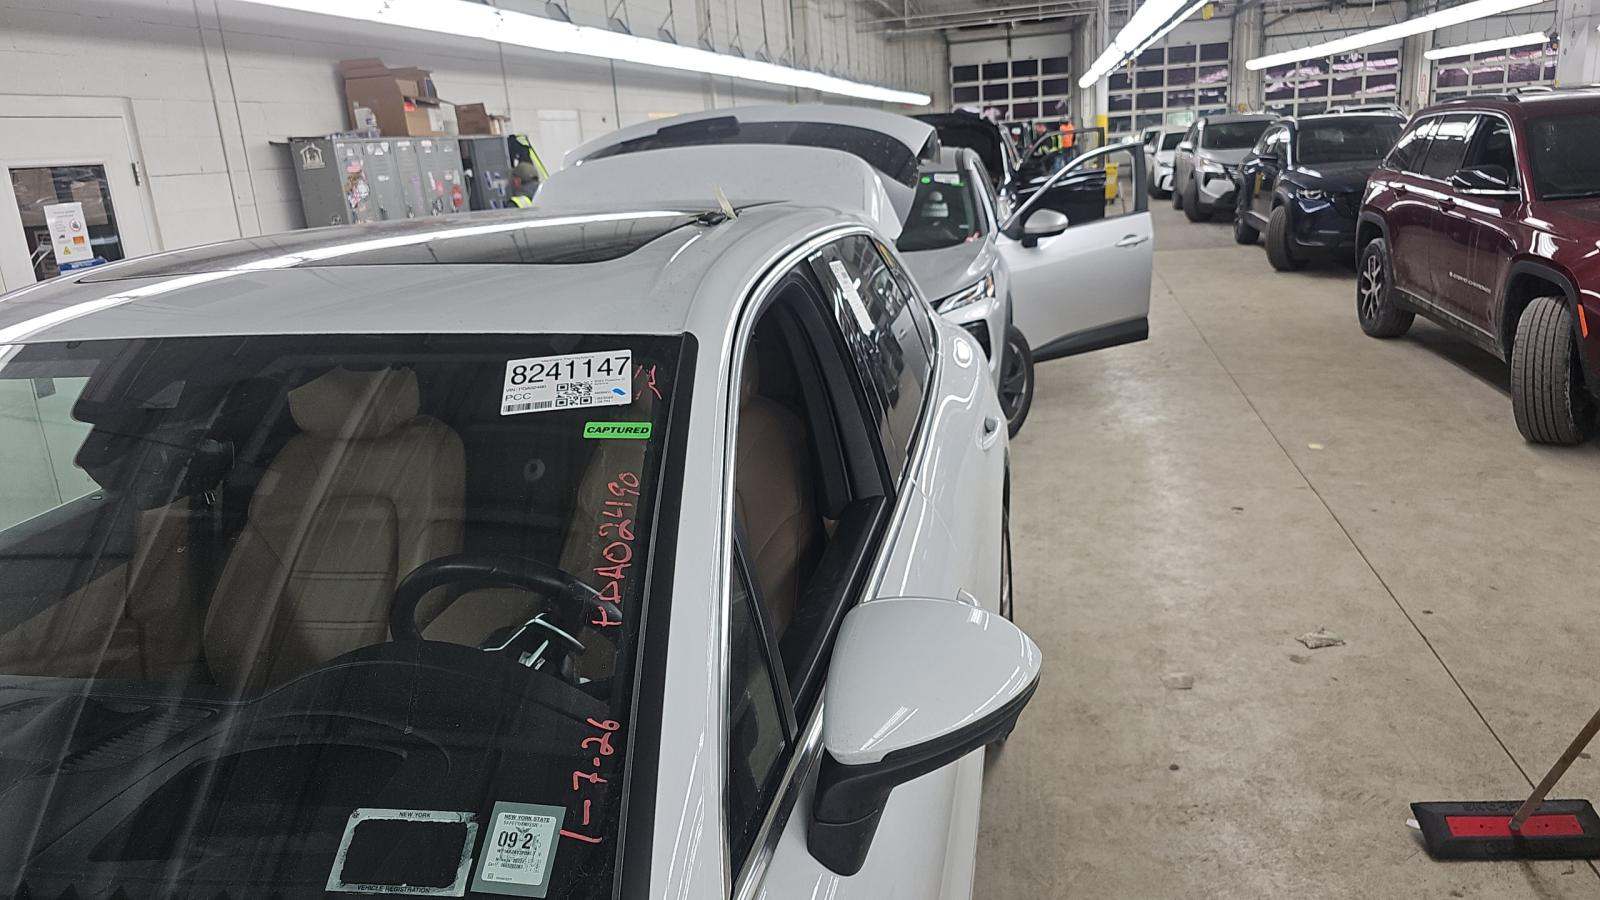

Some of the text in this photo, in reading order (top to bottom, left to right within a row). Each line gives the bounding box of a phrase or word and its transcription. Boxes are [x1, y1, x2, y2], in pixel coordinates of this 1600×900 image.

[511, 356, 630, 385] 8241147
[505, 392, 532, 401] PCC
[586, 426, 650, 434] CAPTURED
[497, 830, 519, 848] 09
